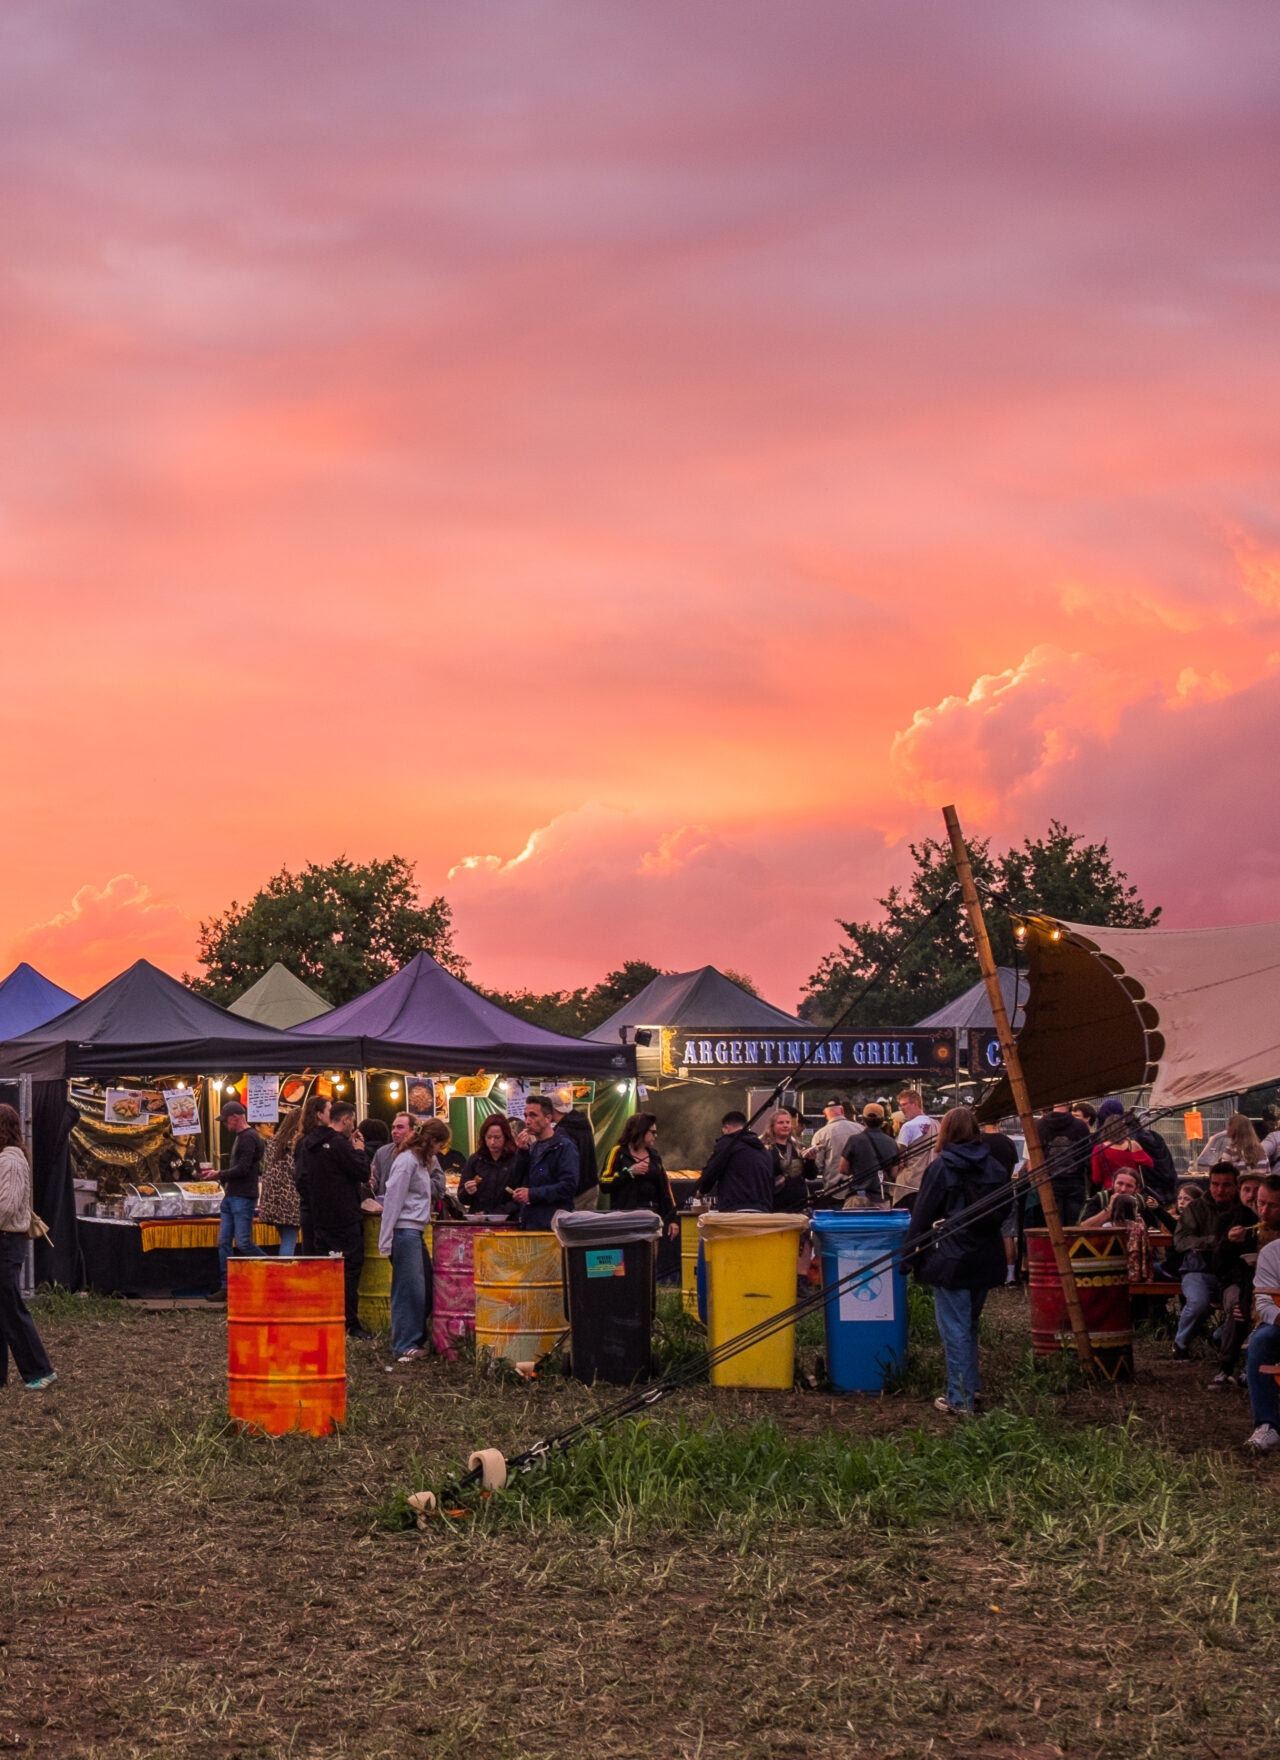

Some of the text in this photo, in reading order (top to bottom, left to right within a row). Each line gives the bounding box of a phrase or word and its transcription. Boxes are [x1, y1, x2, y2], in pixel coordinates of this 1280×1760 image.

[682, 1040, 918, 1066] ARGENTINIAN GRILL
[986, 1040, 1001, 1067] C
